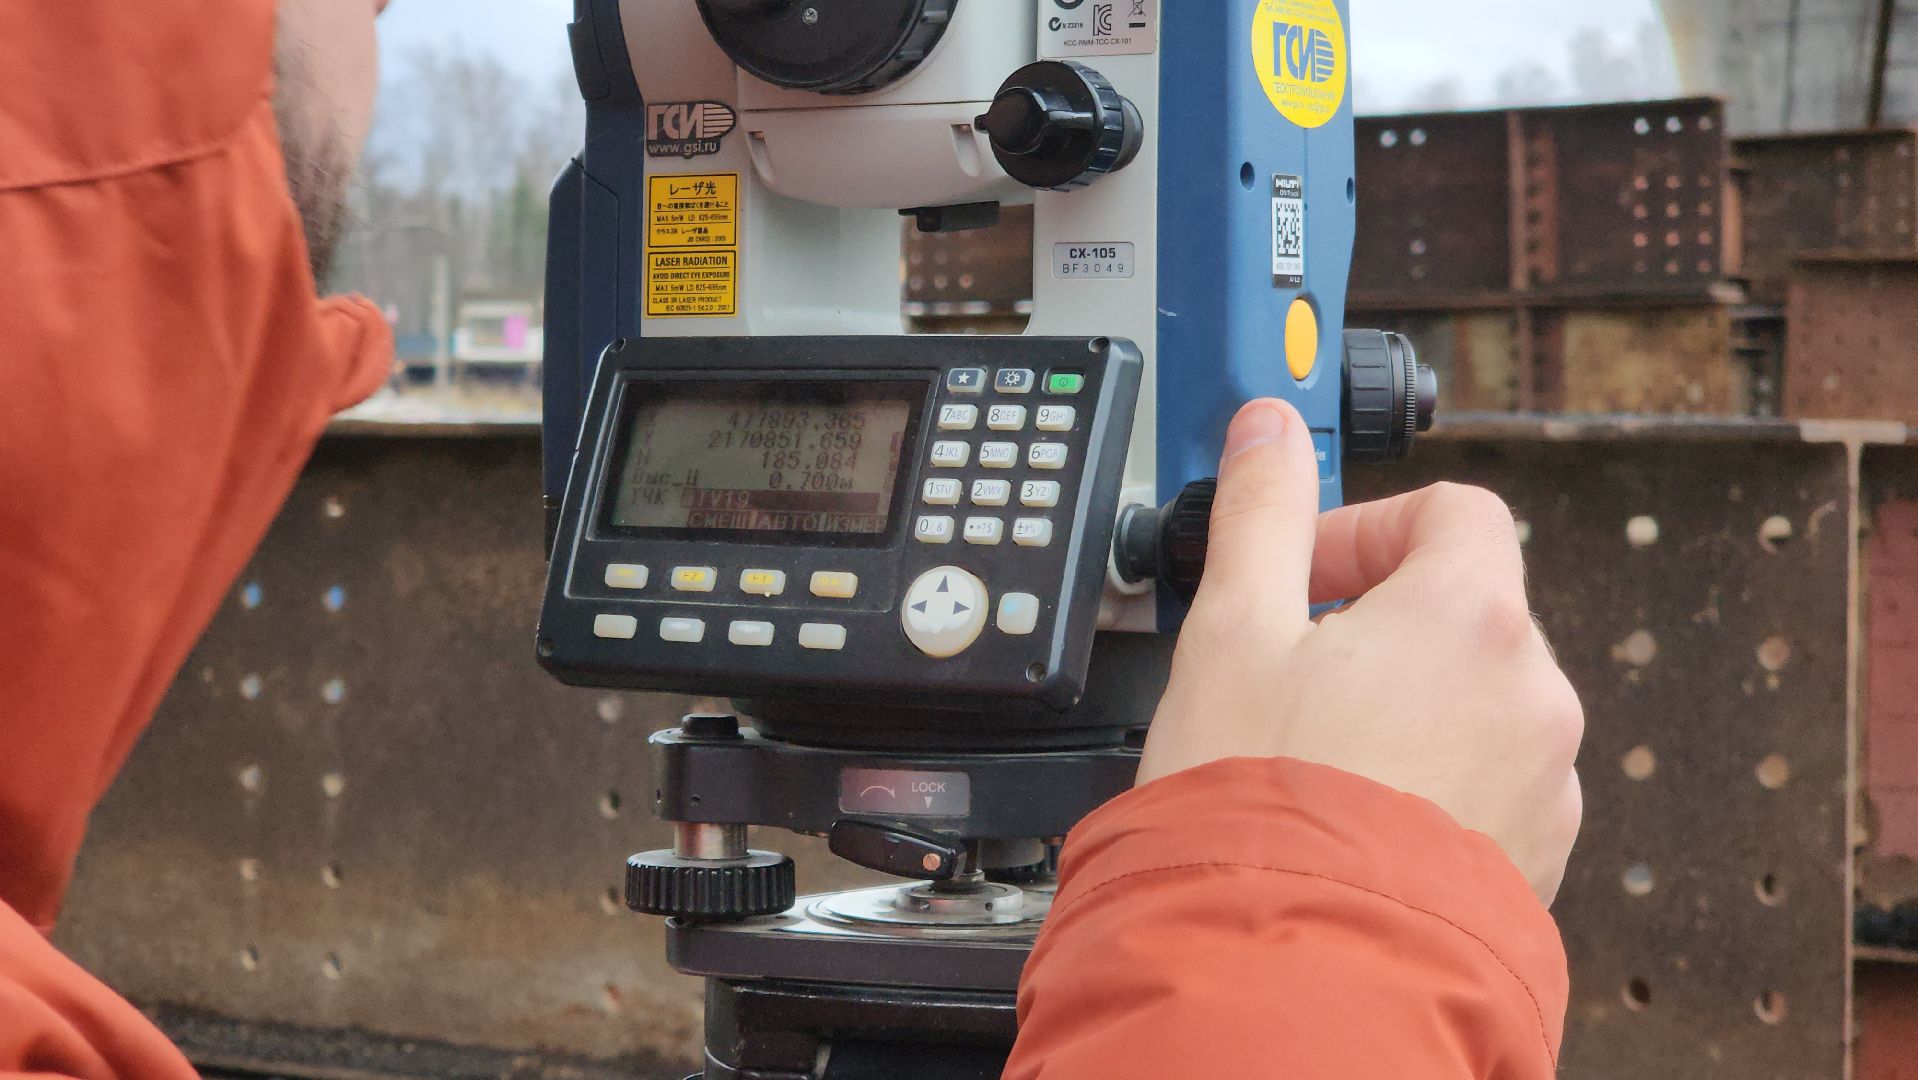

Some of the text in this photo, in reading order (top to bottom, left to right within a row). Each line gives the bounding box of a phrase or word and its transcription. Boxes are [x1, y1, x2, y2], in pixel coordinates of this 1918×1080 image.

[648, 141, 717, 156] www.gsi.ru
[669, 181, 717, 196] レーザ光
[1069, 247, 1116, 259] CX-105
[655, 255, 728, 267] LASER RADIATION
[652, 272, 669, 280] AVOID
[691, 271, 701, 279] EYE
[655, 284, 669, 292] MAX
[911, 781, 946, 793] LOCK
